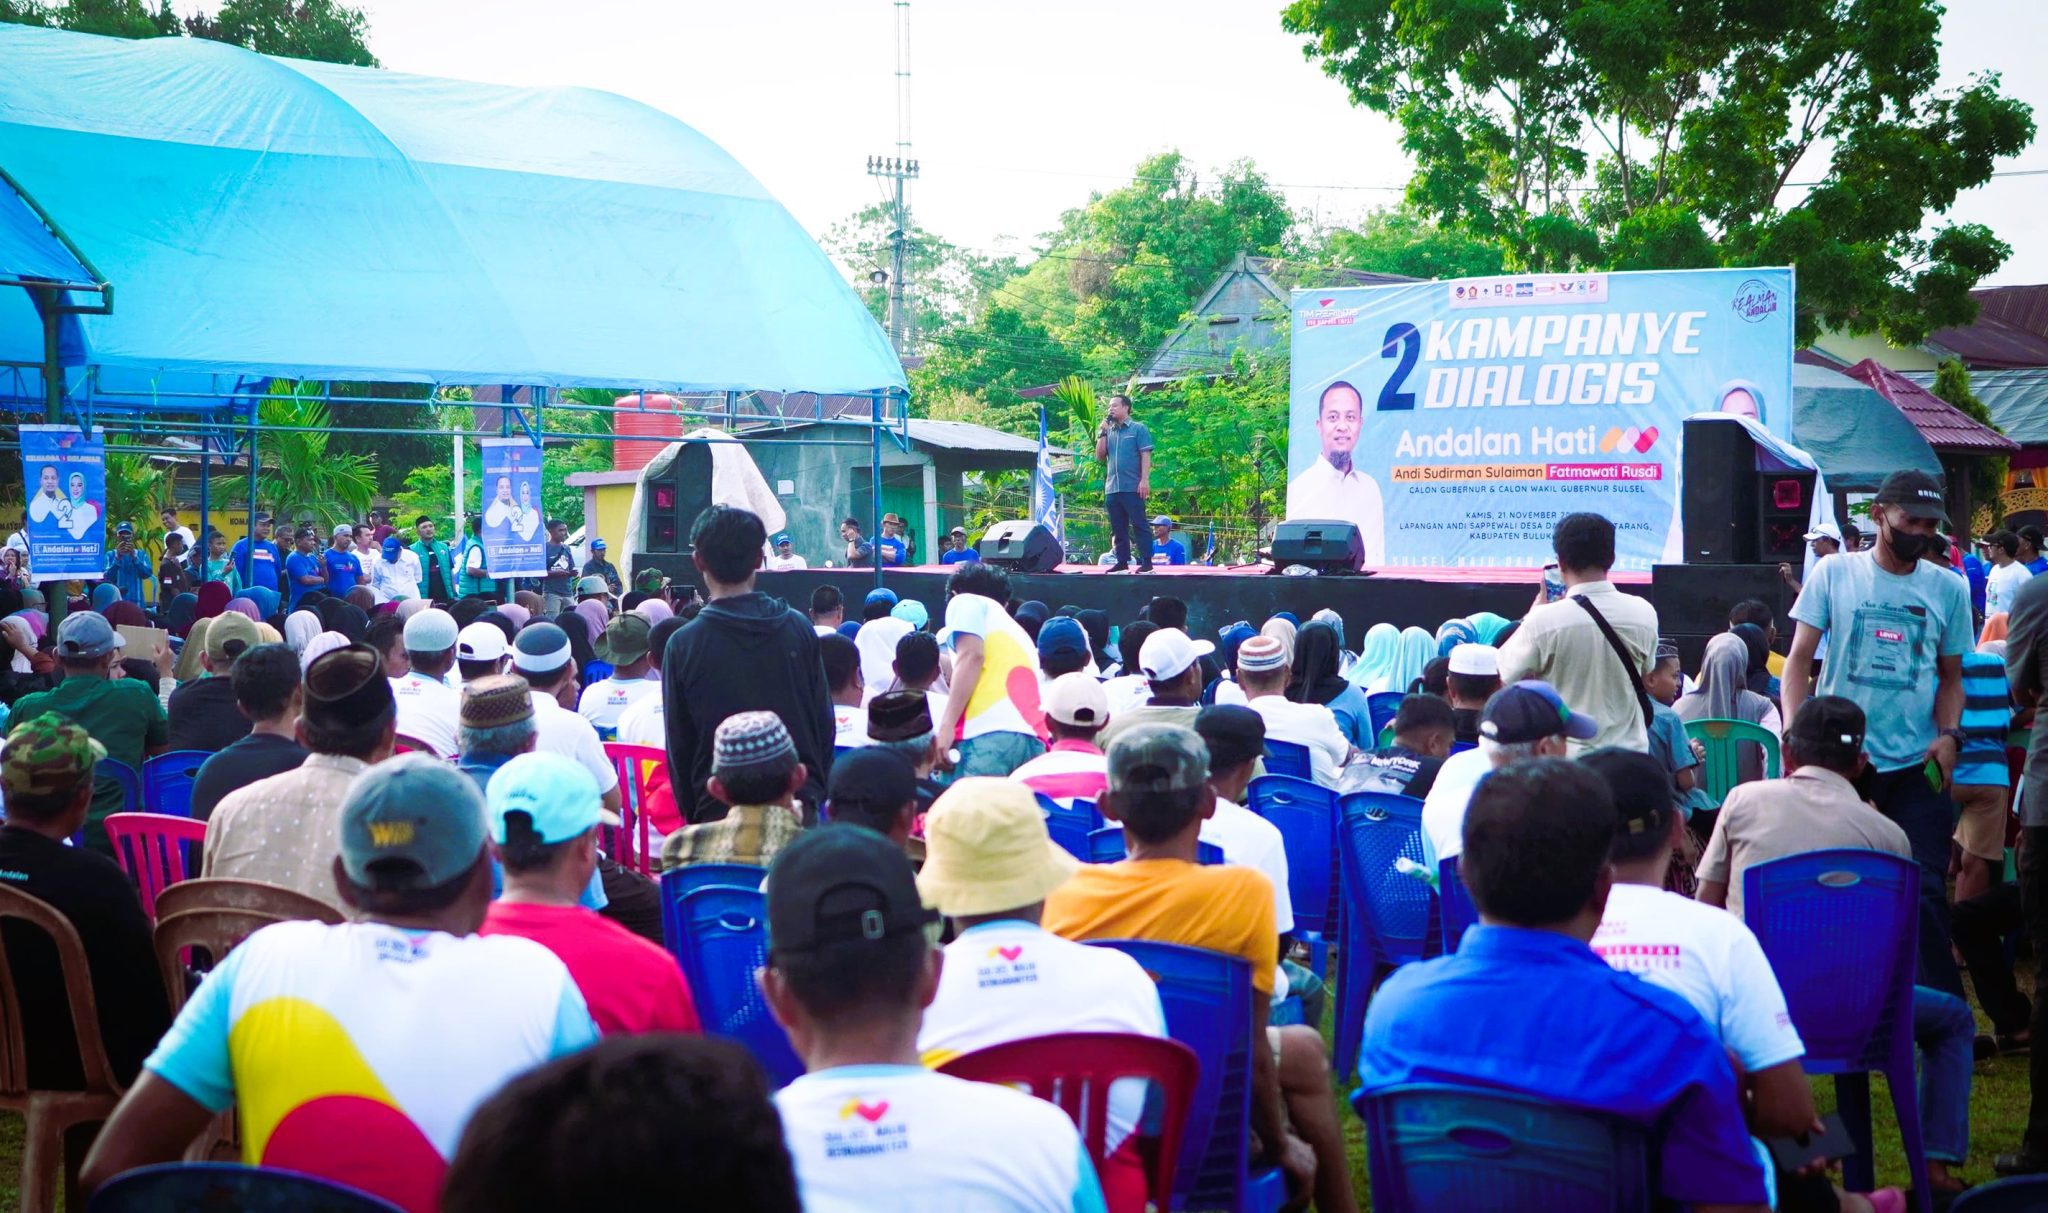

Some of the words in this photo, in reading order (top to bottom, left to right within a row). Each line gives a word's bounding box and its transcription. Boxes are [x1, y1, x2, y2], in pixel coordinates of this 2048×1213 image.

[1424, 311, 1707, 362] KAMPANYE
[1377, 322, 1421, 412] 2
[1423, 361, 1660, 409] DIALOGIS
[1394, 426, 1522, 458] Andalan
[1531, 425, 1596, 456] Hati
[1395, 466, 1421, 480] Andi
[1424, 465, 1482, 479] Sudirman
[1485, 465, 1543, 478] Sulaiman
[1549, 464, 1619, 479] Fatmawati
[1621, 464, 1658, 478] Rusdi
[1409, 486, 1437, 494] CALON
[1440, 486, 1487, 494] GUBERNUR
[1498, 486, 1528, 494] CALON
[1530, 485, 1558, 493] WAKIL
[1561, 485, 1610, 493] GUBERNUR
[1612, 484, 1646, 493] SULSEL
[1466, 511, 1495, 520] KAMIS,
[1498, 511, 1506, 519] 21
[1509, 511, 1557, 519] NOVEMBER
[1399, 522, 1444, 530] LAPANGAN
[1446, 522, 1467, 530] ANDI
[1469, 521, 1518, 530] SAPPEWALI
[1520, 521, 1543, 530] DESA
[1469, 532, 1520, 540] KABUPATEN
